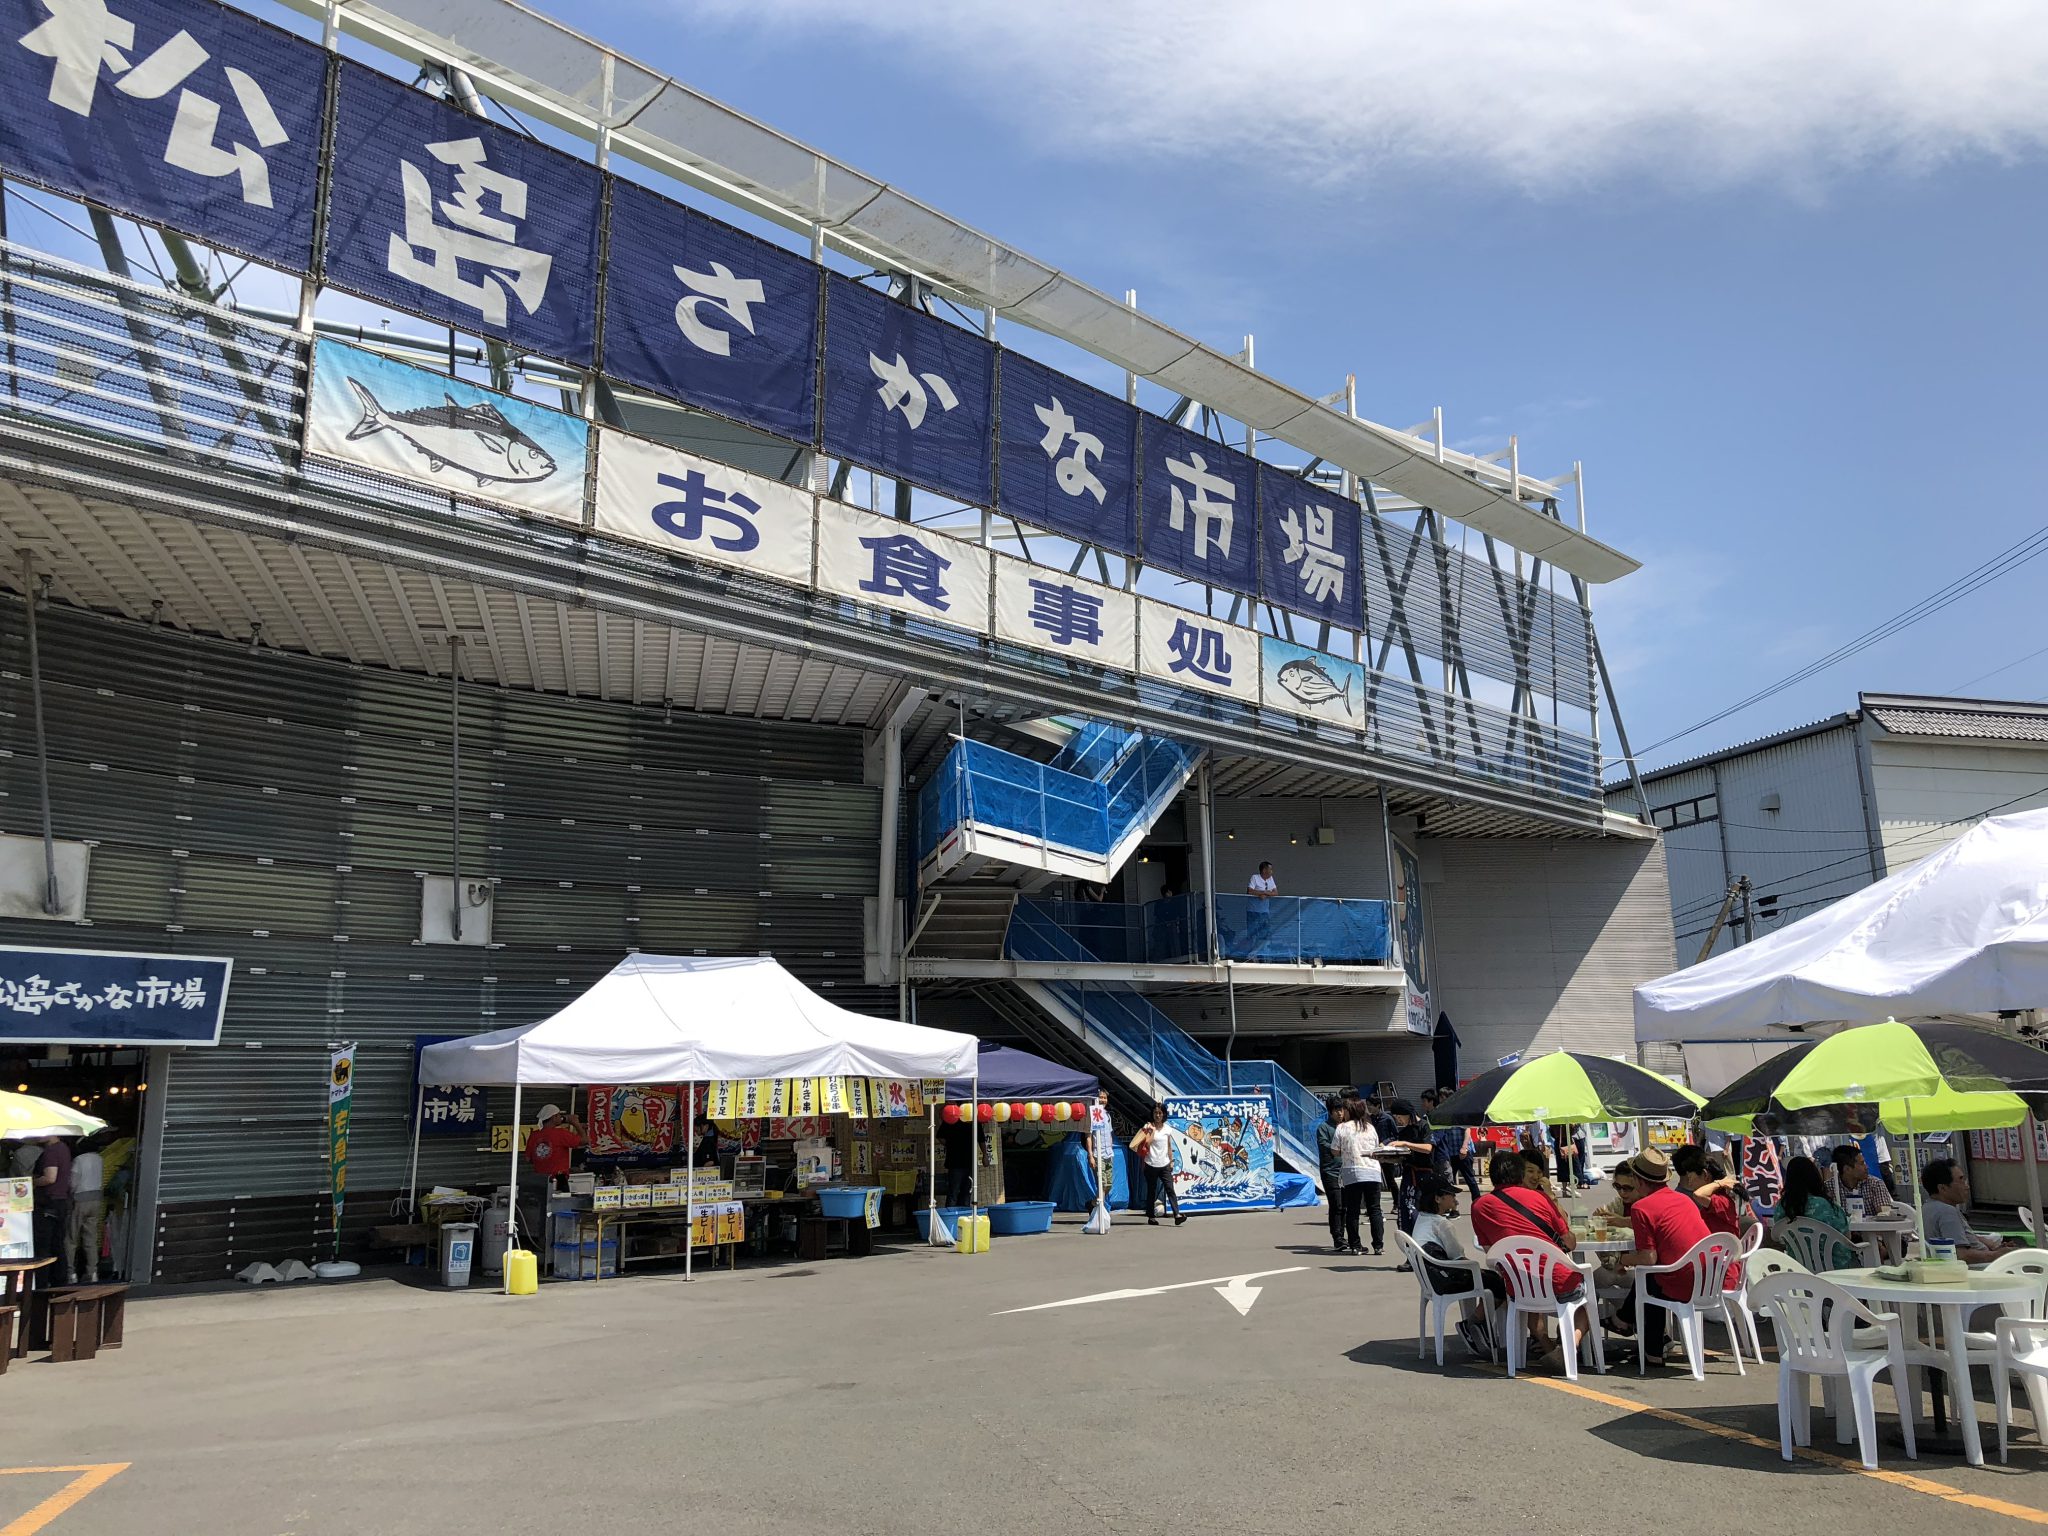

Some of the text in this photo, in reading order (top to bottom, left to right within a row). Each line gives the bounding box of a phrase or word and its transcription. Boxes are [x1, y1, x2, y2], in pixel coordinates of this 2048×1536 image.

[19, 0, 1346, 603] 松島さかな市場
[651, 468, 1233, 688] お食事処
[424, 1097, 476, 1124] 市場
[717, 1080, 729, 1116] いか下足
[772, 1079, 783, 1114] 牛たん焼
[802, 1078, 812, 1113] かき串
[853, 1081, 863, 1115] ほたて焼
[876, 1081, 886, 1116] かき氷
[889, 1082, 906, 1105] 氷
[1166, 1099, 1269, 1122] 松島さかな市場
[1091, 1108, 1104, 1122] 氷
[655, 1124, 671, 1151] 大入
[699, 1209, 708, 1243] 生ビール
[726, 1207, 736, 1240] 生ビール
